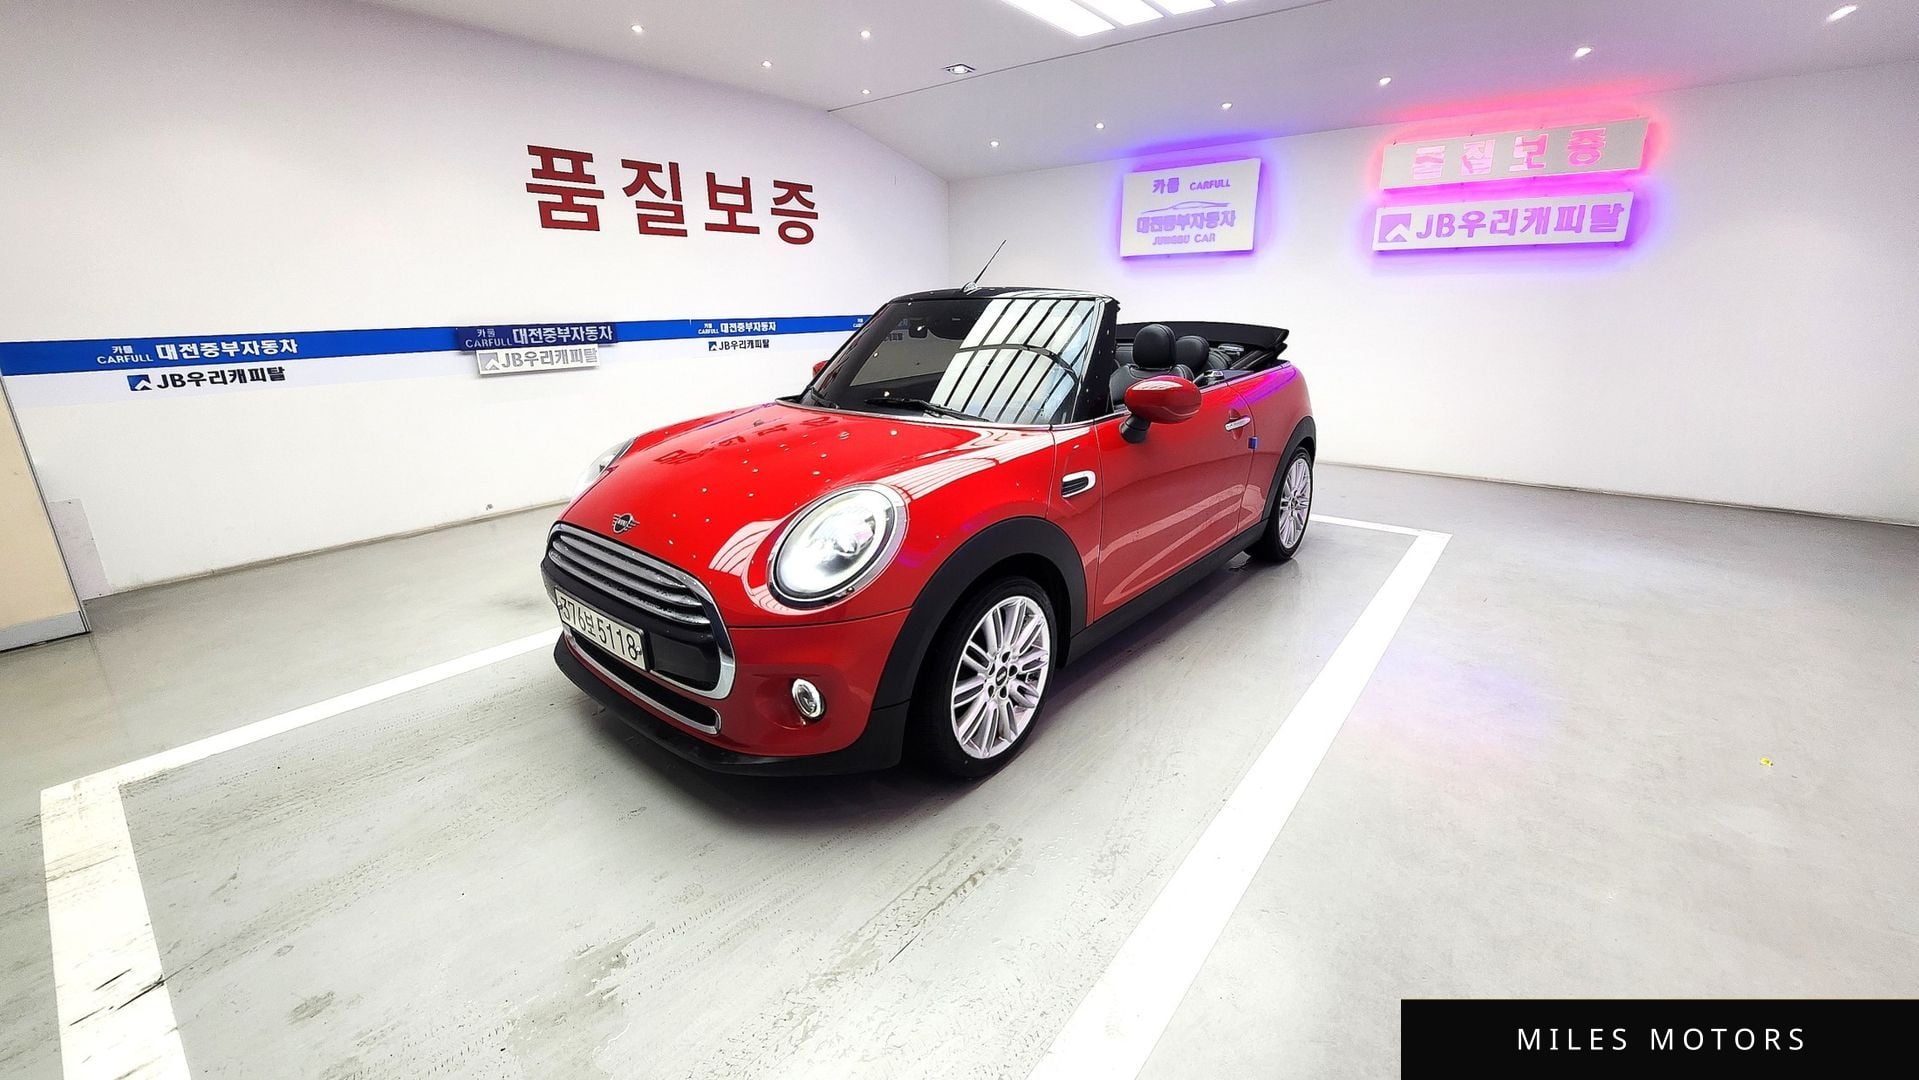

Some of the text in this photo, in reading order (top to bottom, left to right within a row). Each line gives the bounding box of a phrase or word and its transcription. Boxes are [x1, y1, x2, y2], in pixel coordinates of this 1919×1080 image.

[1190, 179, 1231, 191] CARFULL
[525, 144, 819, 245] 품질보증
[1416, 203, 1625, 239] JB우리캐피탈
[1194, 232, 1216, 243] CAR
[465, 337, 513, 348] CARFULL
[718, 339, 770, 351] JB우리캐피탈
[96, 354, 154, 365] CARFULL
[501, 348, 598, 368] JB우리캐피탈
[156, 366, 286, 390] JB우리캐피탈
